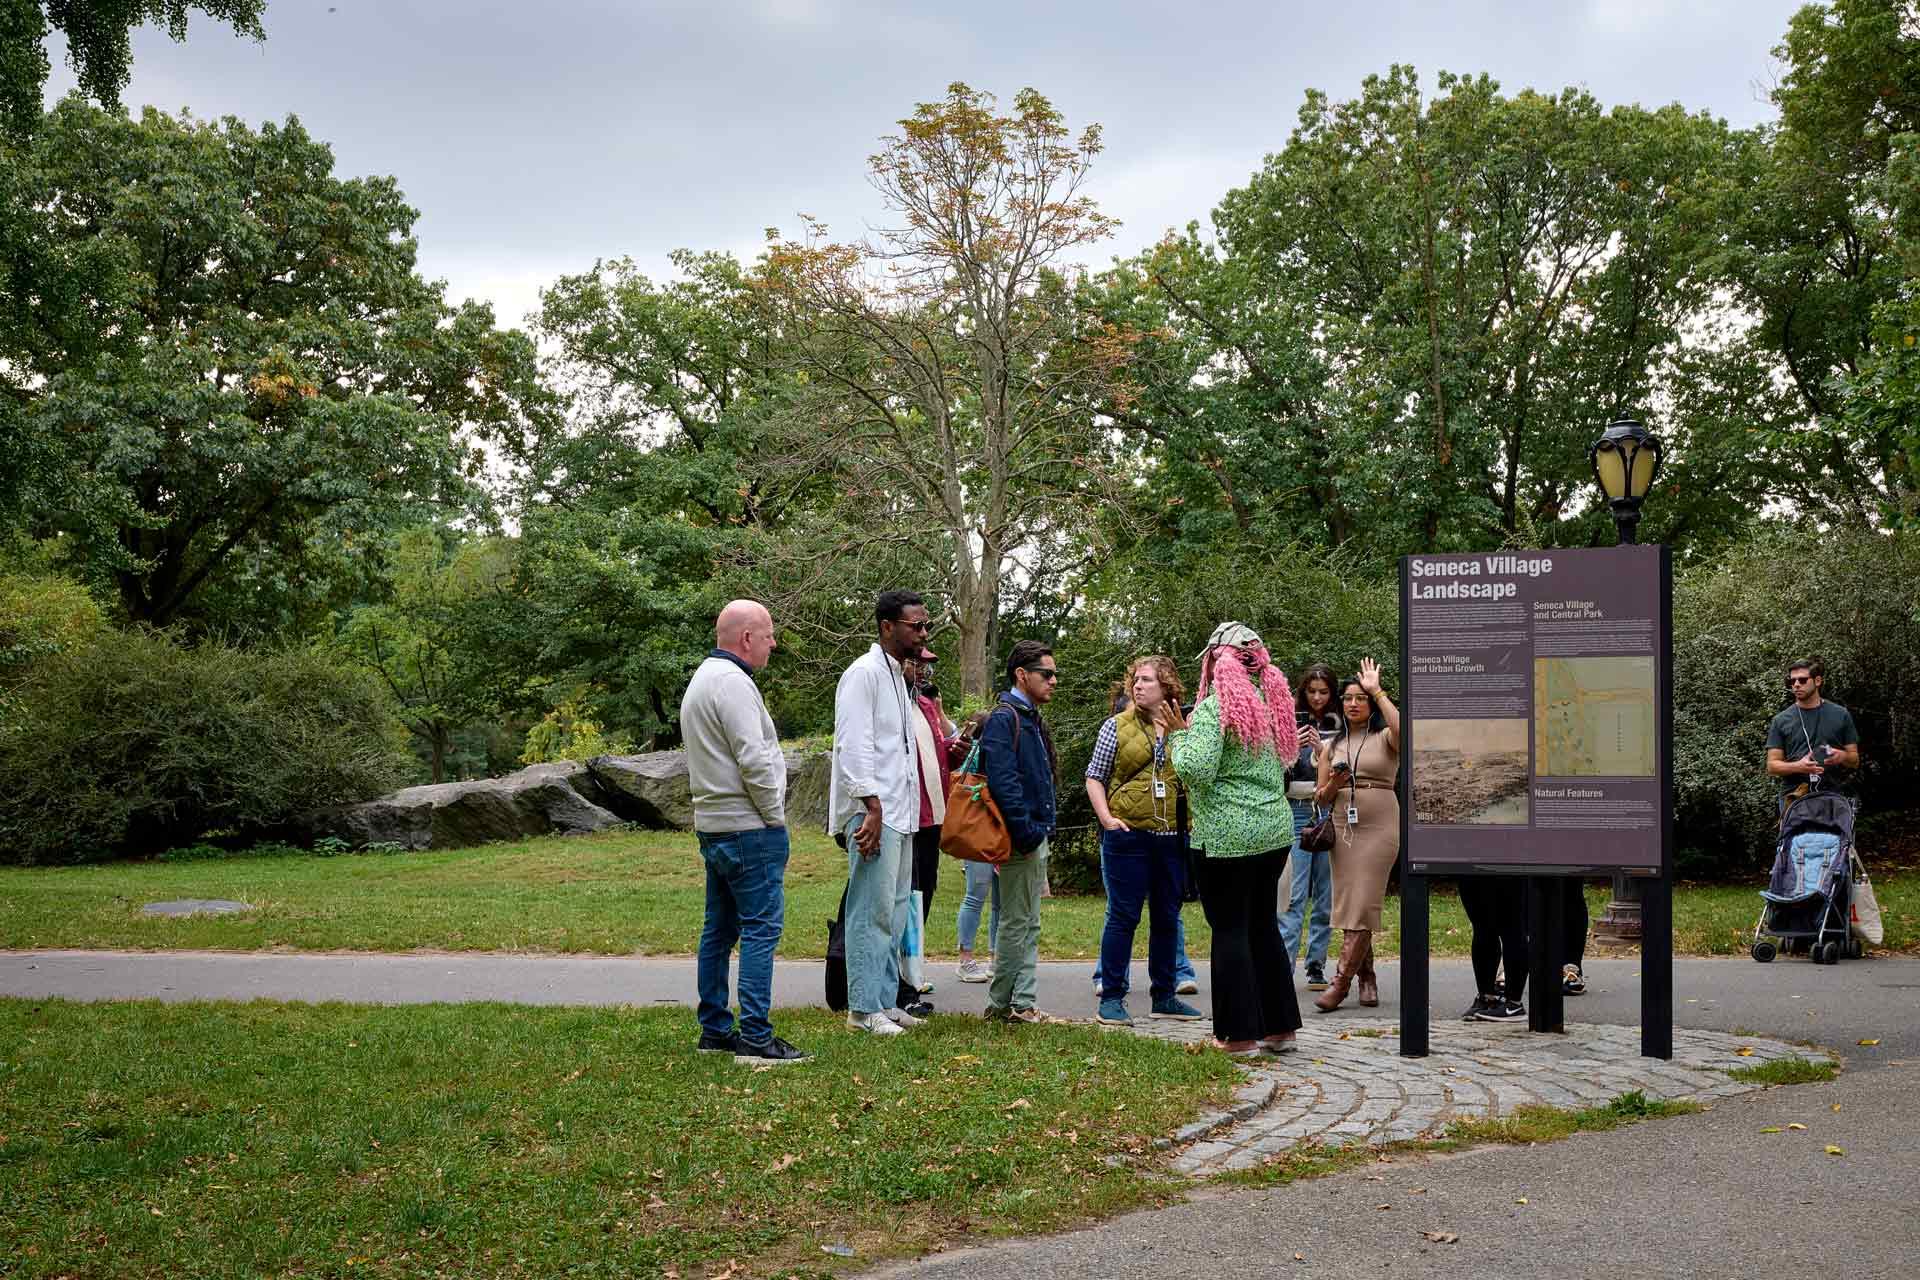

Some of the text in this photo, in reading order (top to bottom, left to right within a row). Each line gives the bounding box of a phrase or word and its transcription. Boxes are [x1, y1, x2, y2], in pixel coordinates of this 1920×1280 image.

[1411, 556, 1553, 577] Seneca Village
[1411, 581, 1517, 600] Landscape
[1534, 600, 1594, 611] Seneca Village
[1534, 608, 1603, 619] and Central Park
[1412, 655, 1470, 666] Seneca Village
[1412, 663, 1485, 673] and Urban Growth
[1535, 788, 1603, 798] Natural Features
